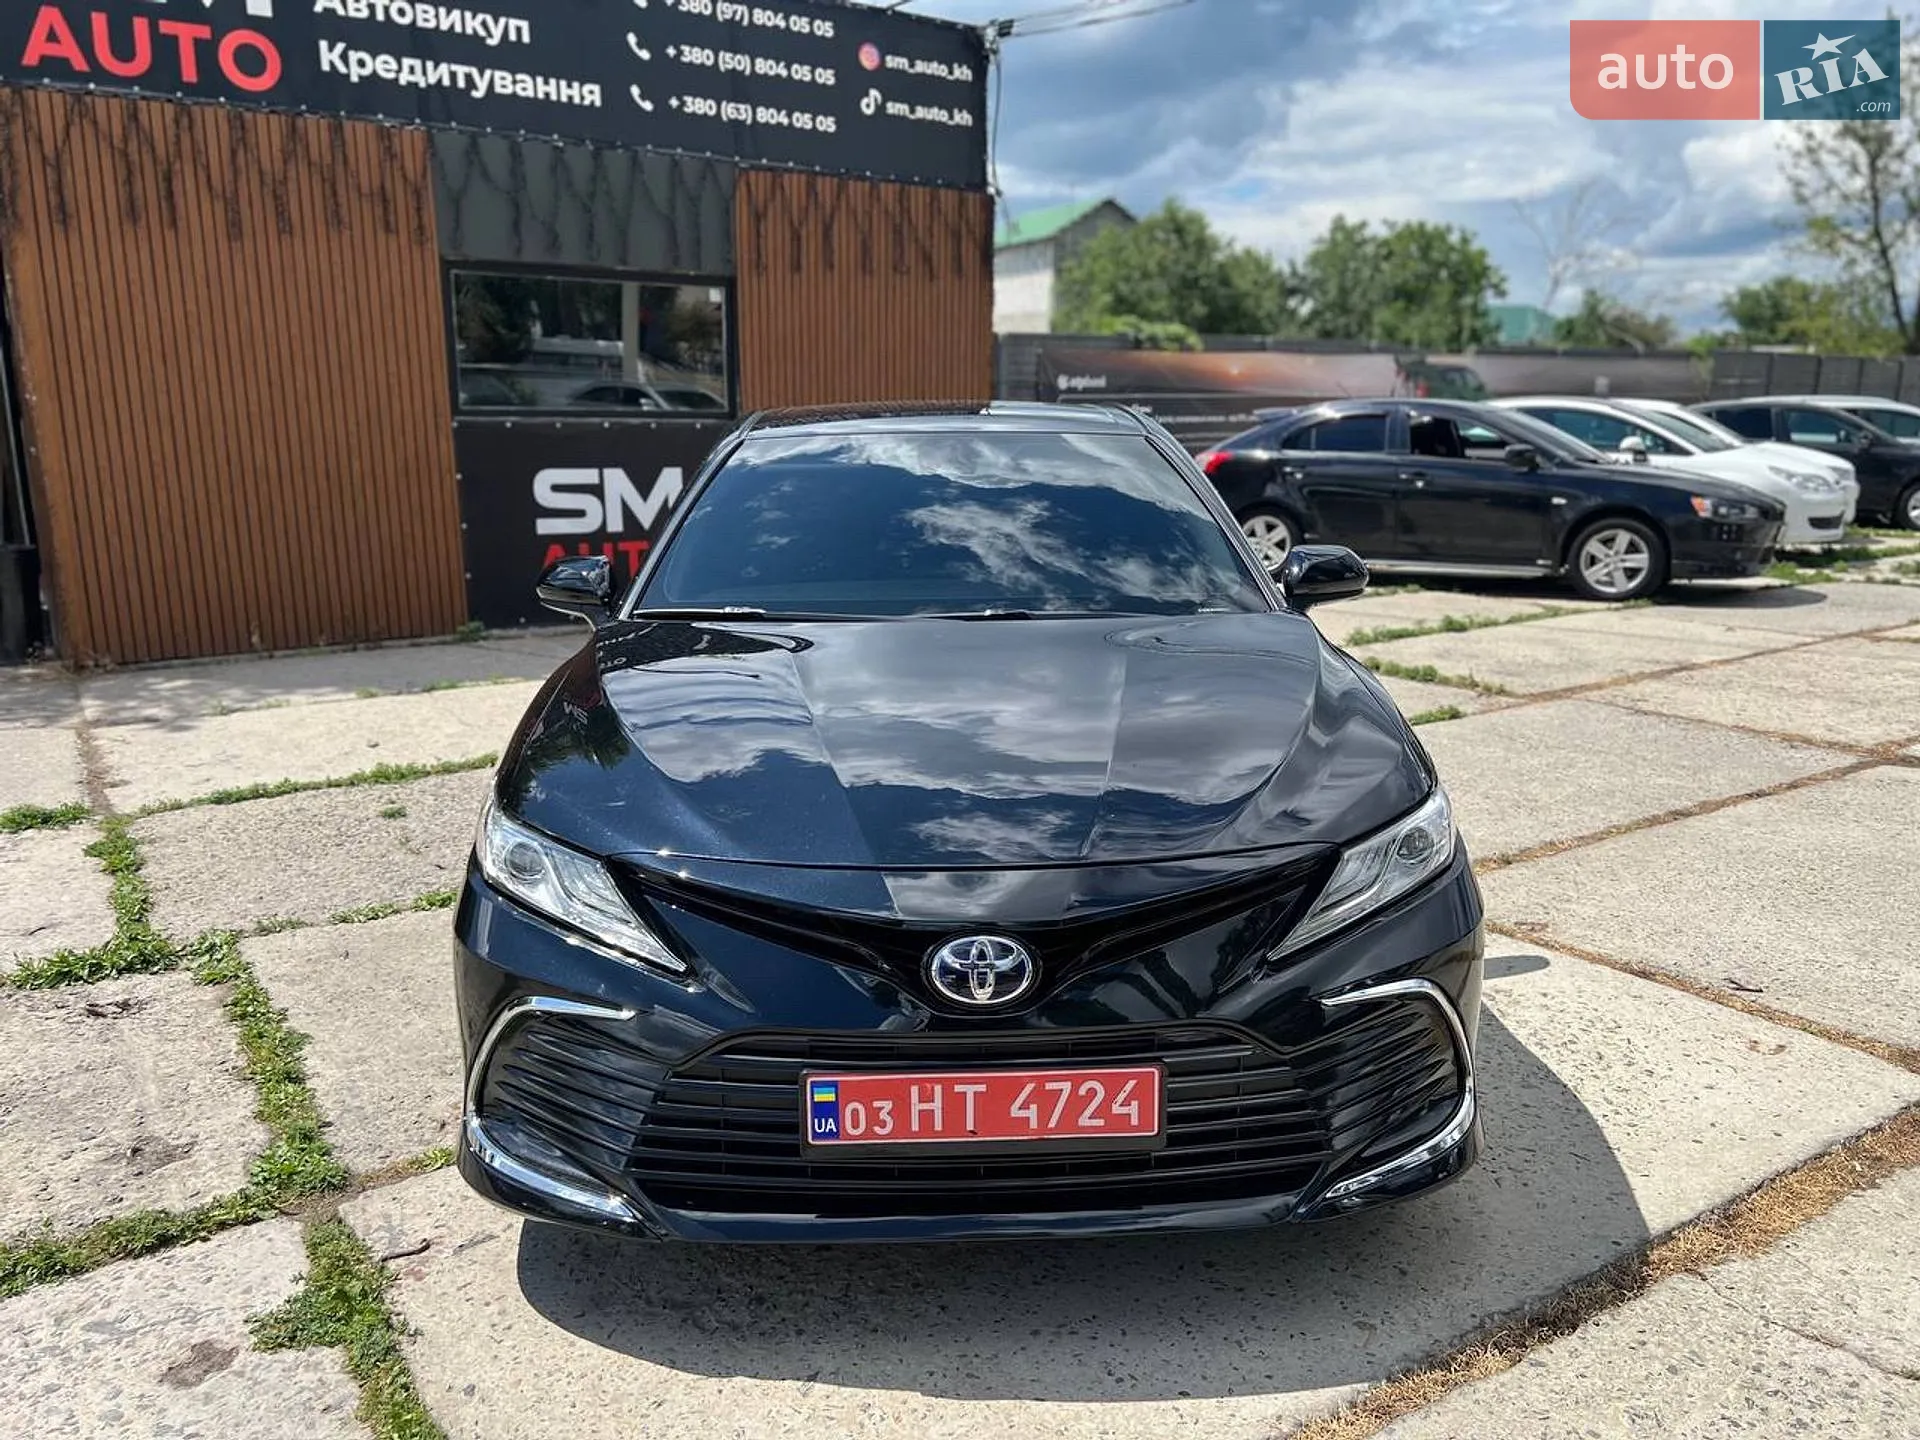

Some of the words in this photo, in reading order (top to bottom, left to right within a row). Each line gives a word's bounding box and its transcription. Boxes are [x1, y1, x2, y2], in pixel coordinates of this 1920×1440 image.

[716, 0, 749, 26] (97)
[752, 8, 786, 29] 804
[789, 15, 811, 34] 05
[812, 21, 835, 38] 05
[21, 5, 282, 92] AUTO
[679, 44, 715, 66] 380
[718, 50, 750, 76] (50)
[754, 57, 788, 78] 804
[791, 63, 812, 82] 05
[815, 67, 836, 85] 05
[885, 54, 973, 82] sm_auto_kh
[318, 39, 602, 107] Кредитування
[682, 95, 717, 116] 380
[720, 100, 753, 125] (63)
[756, 106, 789, 126] 804
[792, 111, 813, 130] 05
[815, 115, 837, 133] 05
[885, 101, 973, 127] sm_auto_kh
[533, 467, 683, 535] SM
[814, 1118, 837, 1133] UA
[844, 1101, 894, 1136] 03
[910, 1083, 987, 1132] HT
[1010, 1079, 1139, 1129] 4724
